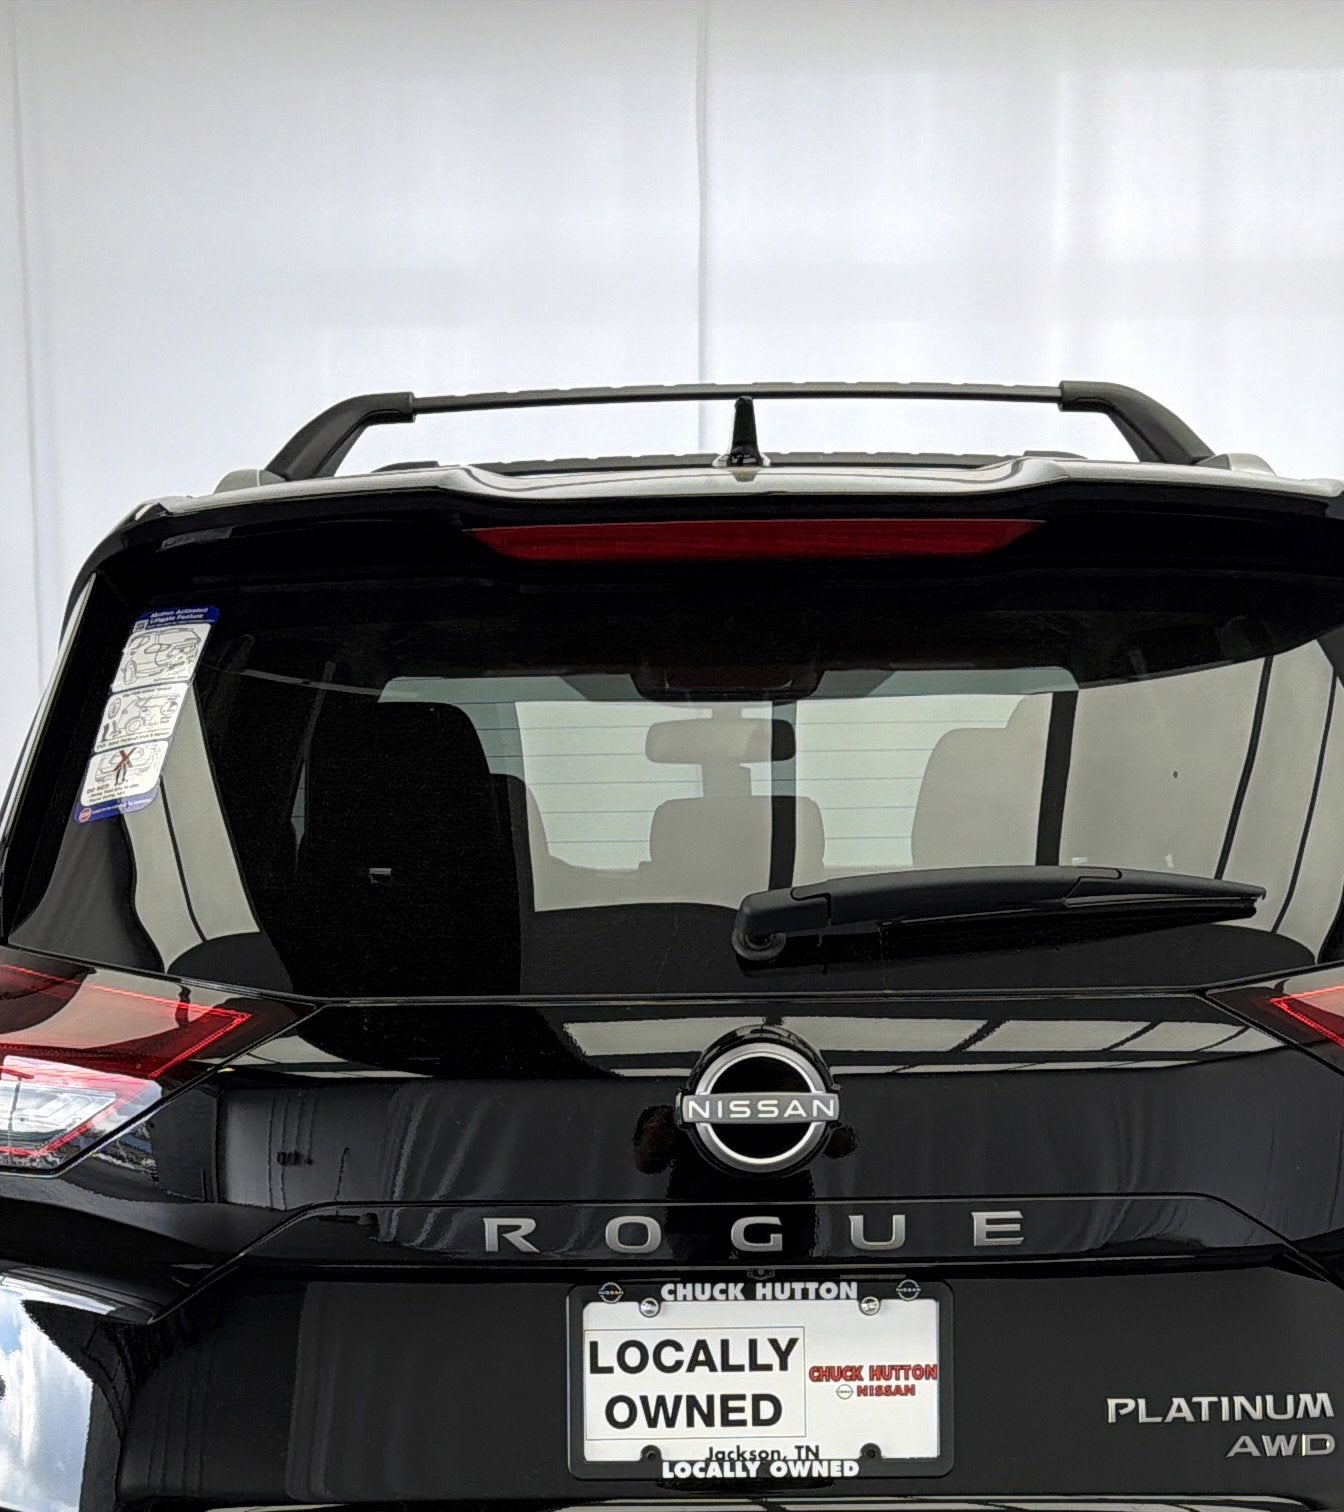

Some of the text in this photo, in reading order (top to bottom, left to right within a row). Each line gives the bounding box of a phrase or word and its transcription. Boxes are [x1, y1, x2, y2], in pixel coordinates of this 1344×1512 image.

[688, 1098, 836, 1119] NISSAN
[482, 1210, 1025, 1253] ROGUE
[661, 1281, 857, 1300] CHUCK HUTTON
[589, 1337, 799, 1374] LOCALLY
[809, 1364, 938, 1382] CHUCK HUTTON
[856, 1384, 916, 1397] NISSAN
[605, 1393, 783, 1430] OWNED
[1107, 1392, 1335, 1424] PLATINUM
[706, 1445, 819, 1461] Jackson, TN
[1225, 1433, 1336, 1458] AWD
[662, 1460, 860, 1479] LOCALLY OWNED
